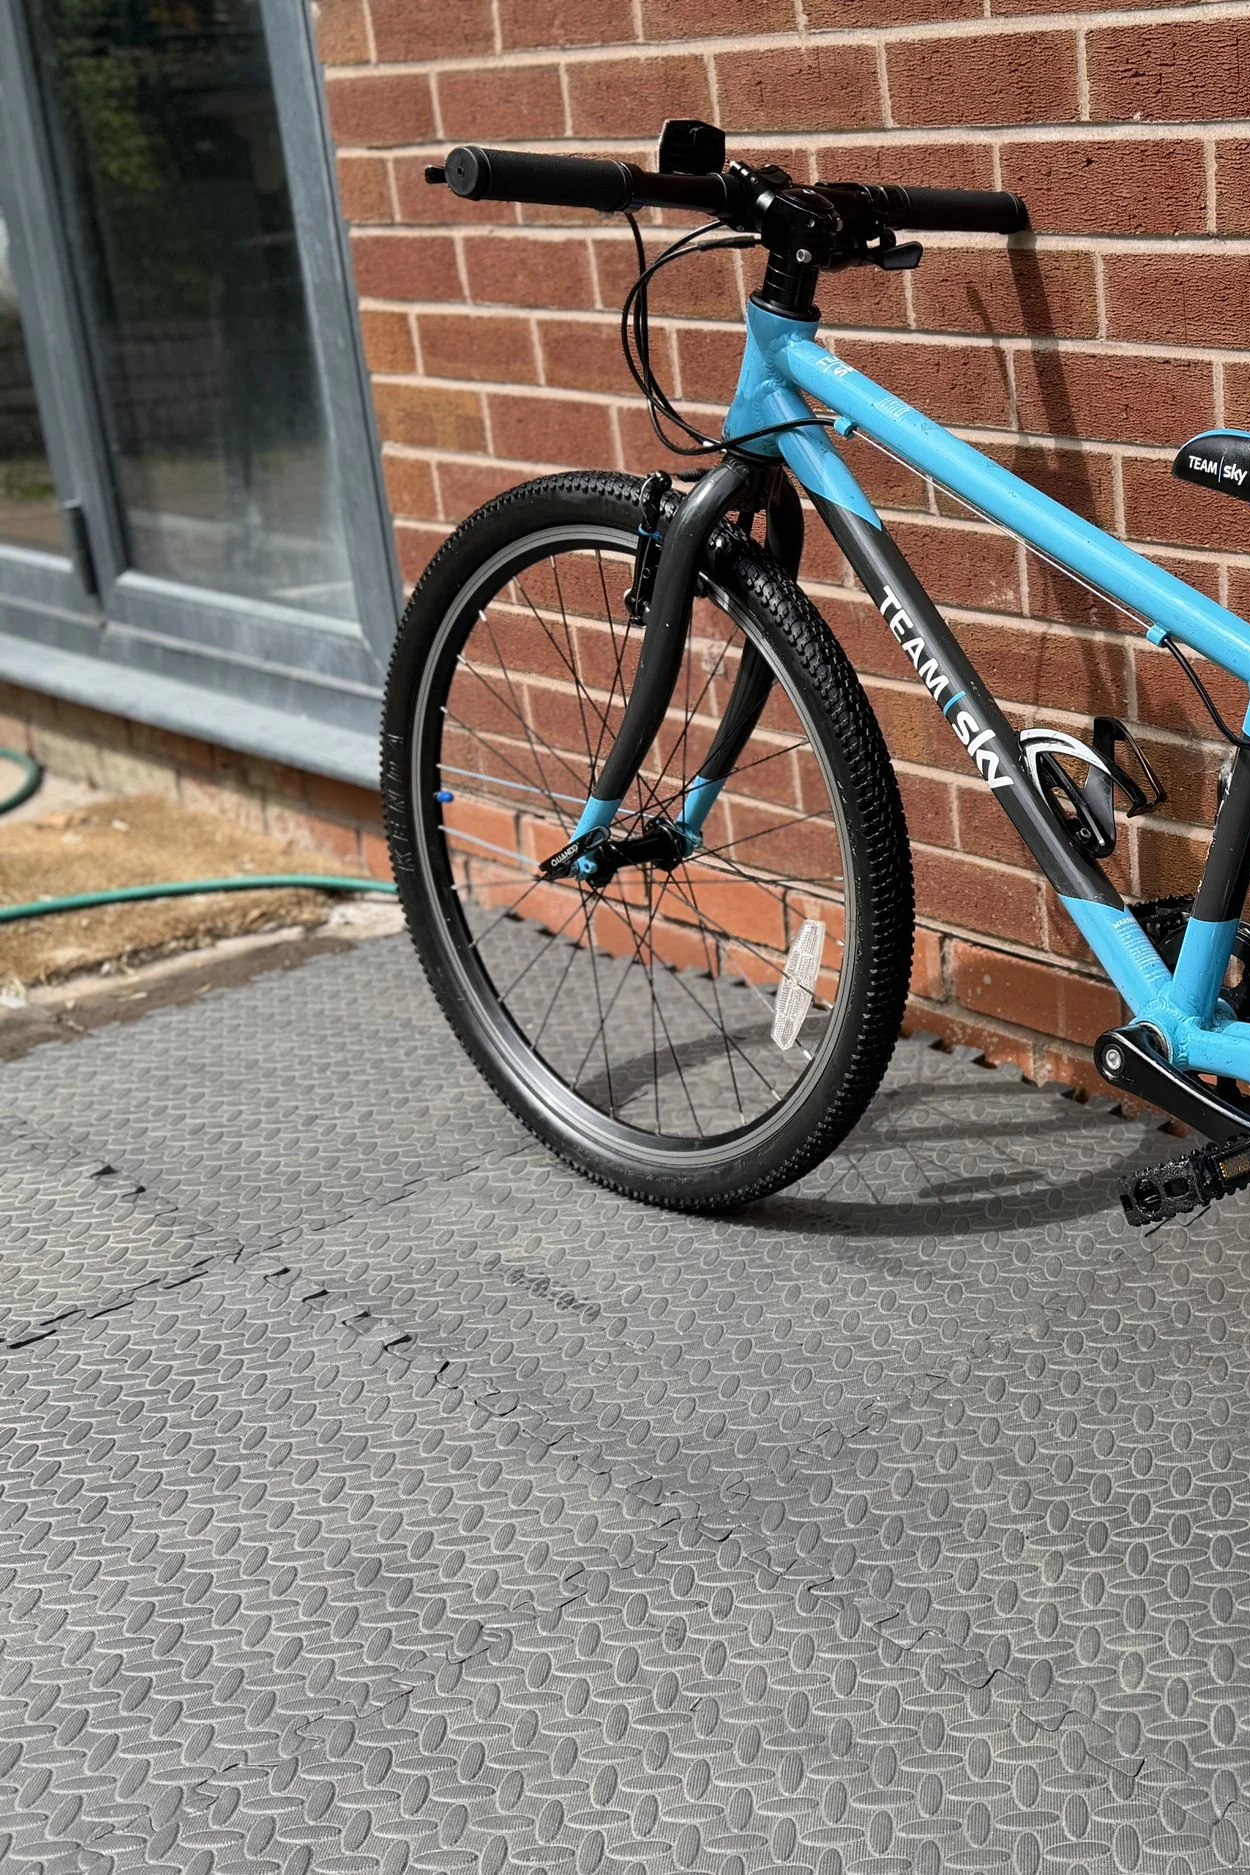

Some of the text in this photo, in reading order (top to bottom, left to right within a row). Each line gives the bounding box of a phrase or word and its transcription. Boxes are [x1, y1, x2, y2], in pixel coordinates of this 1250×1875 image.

[1189, 455, 1248, 486] TEAM sky
[879, 585, 1014, 789] TEAM sky
[387, 733, 414, 872] KENDA
[550, 844, 579, 867] QUANDO
